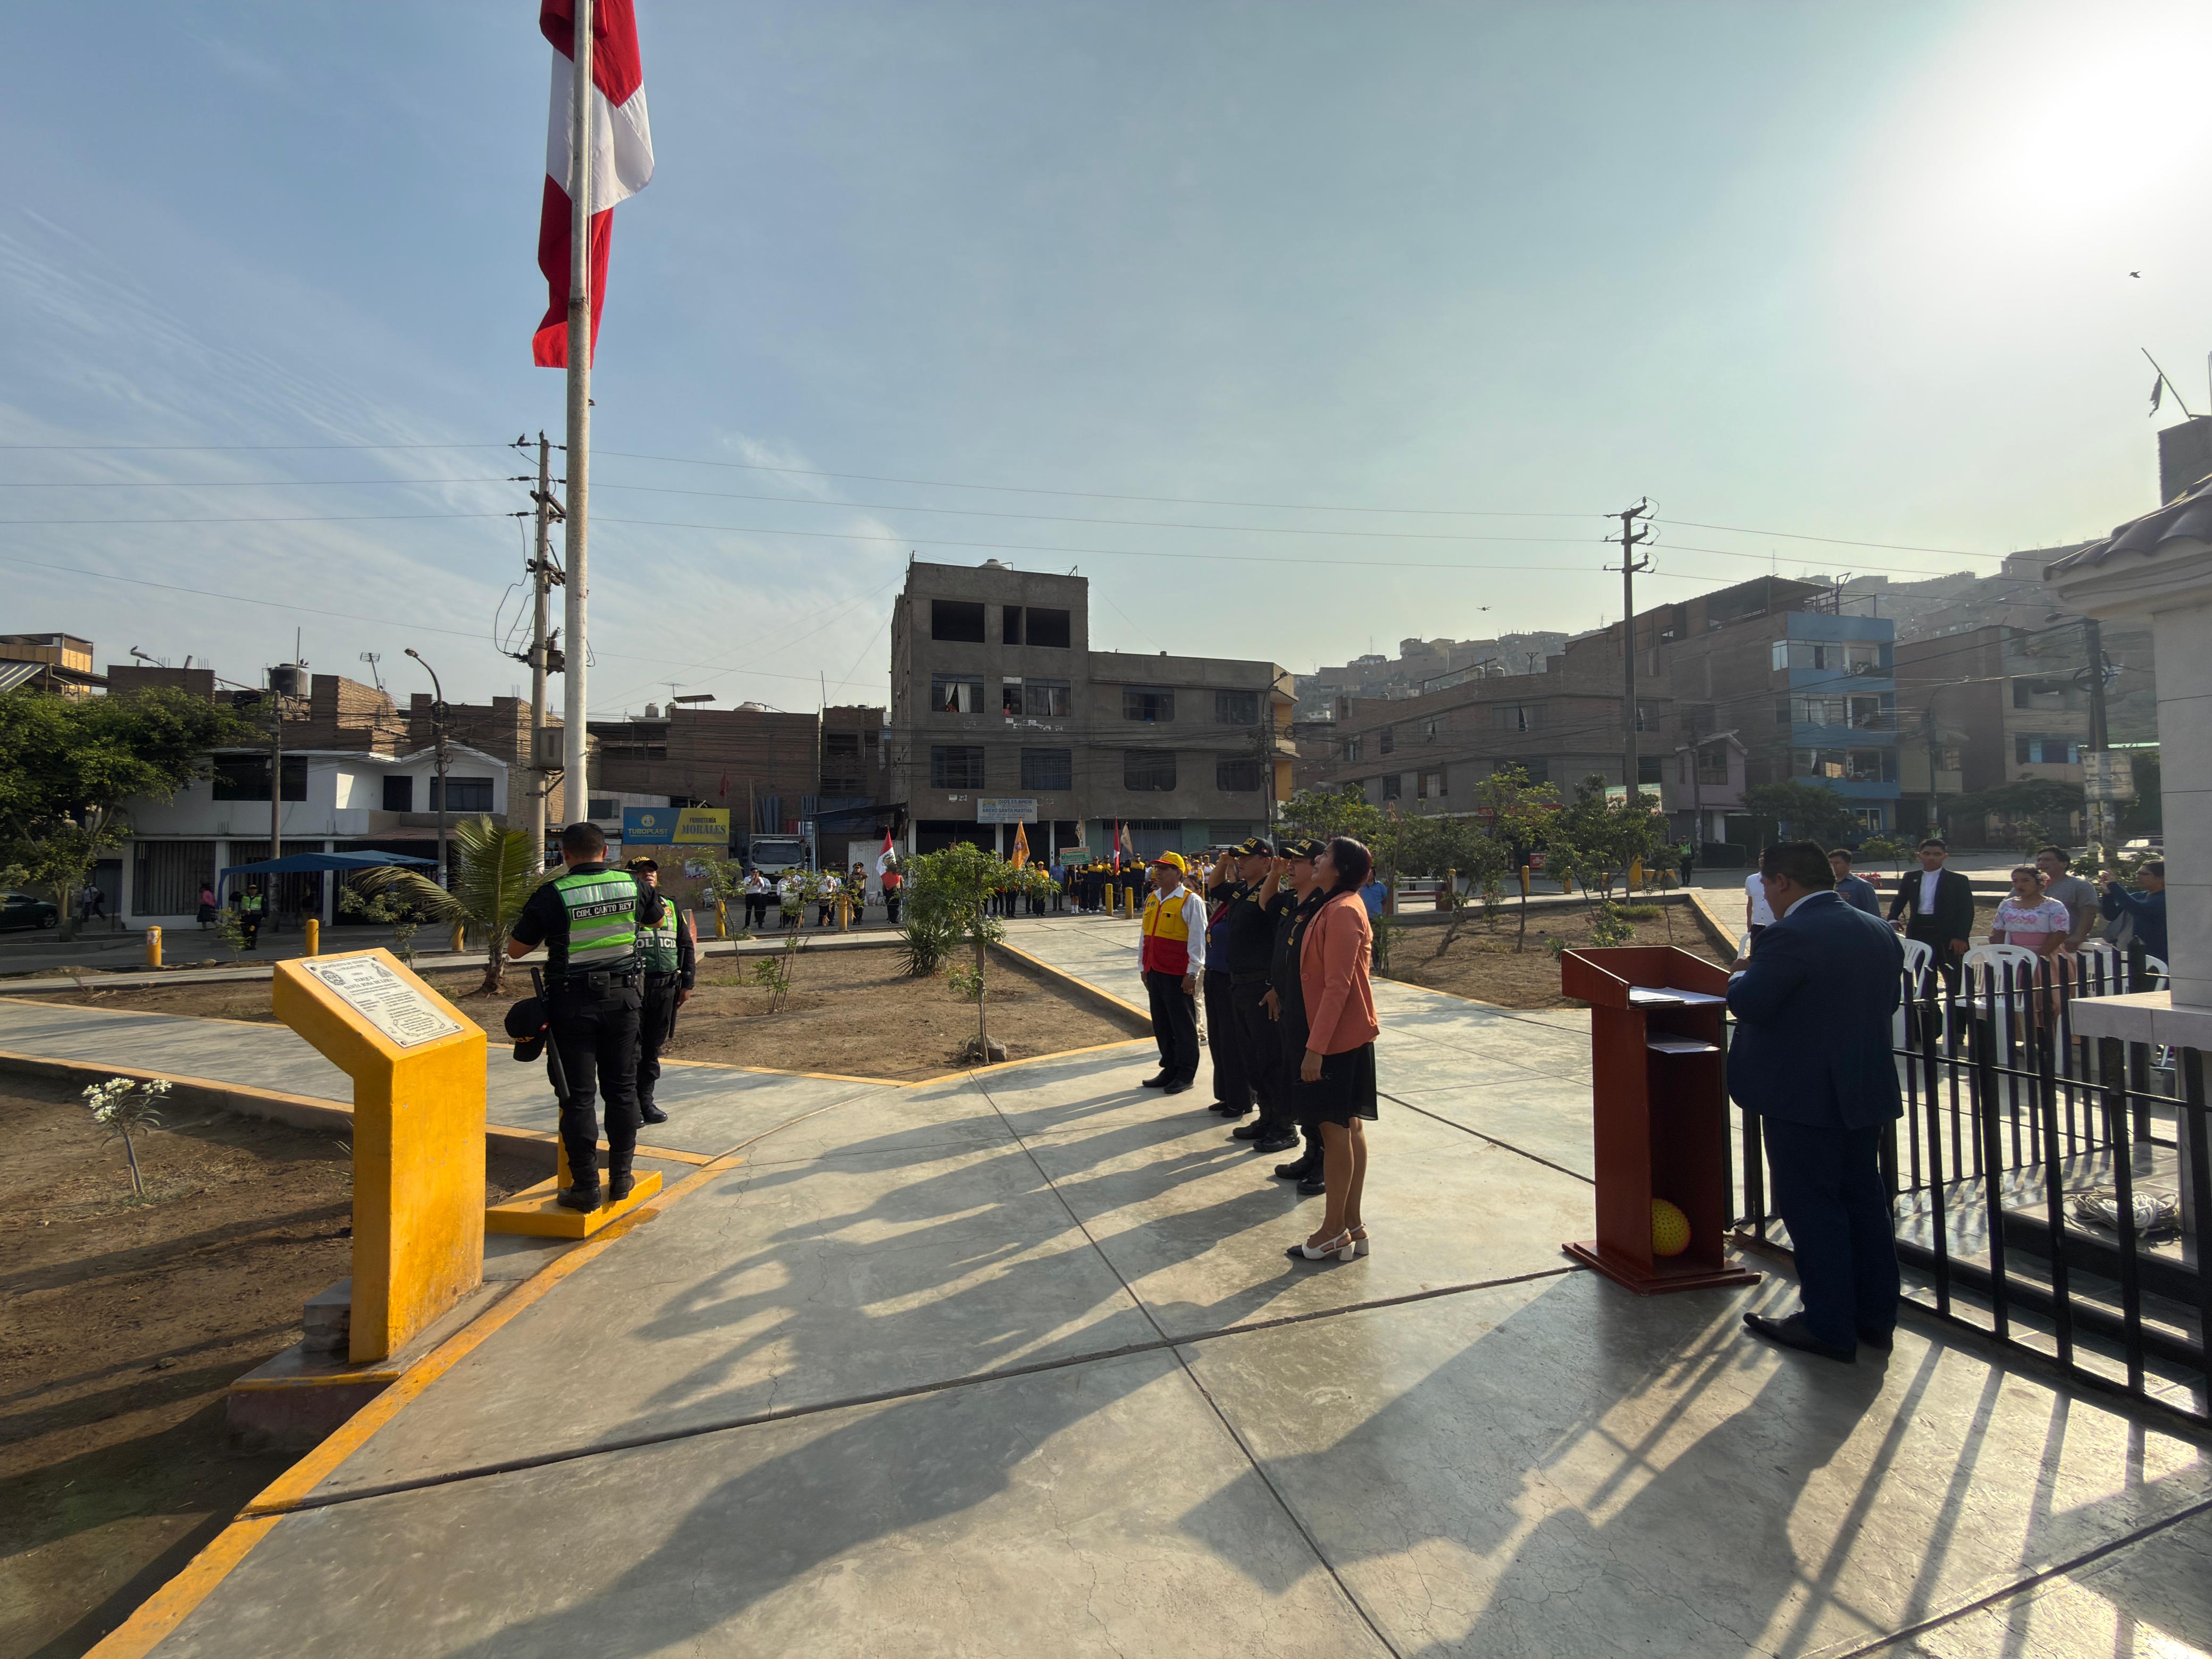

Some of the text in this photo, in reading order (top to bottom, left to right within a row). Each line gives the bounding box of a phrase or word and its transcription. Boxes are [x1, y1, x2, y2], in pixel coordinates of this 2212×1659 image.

[682, 825, 726, 834] MORALES
[576, 901, 632, 918] COM. CANTO REY
[636, 938, 676, 949] OLICIA
